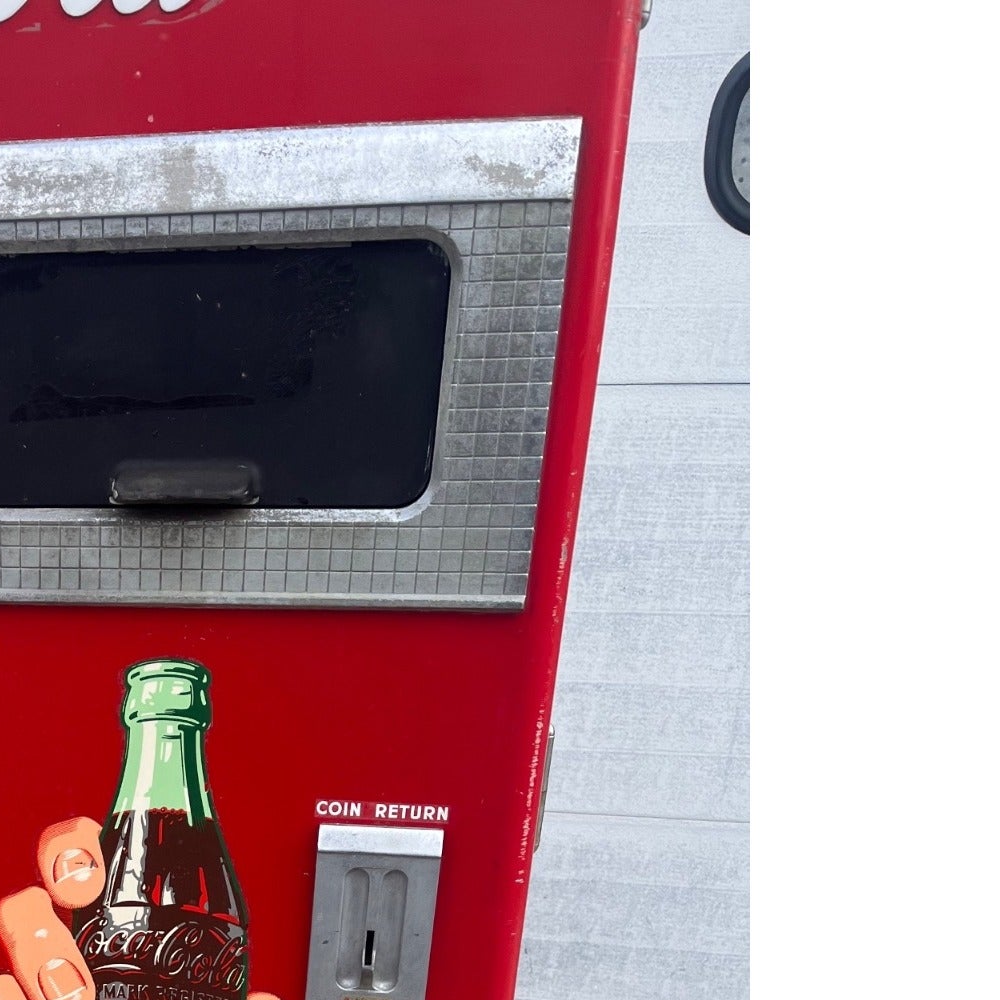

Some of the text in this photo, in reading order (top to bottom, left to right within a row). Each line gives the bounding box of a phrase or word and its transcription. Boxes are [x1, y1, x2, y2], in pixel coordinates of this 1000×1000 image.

[316, 800, 449, 821] COIN RETURN
[103, 983, 150, 1000] MARK
